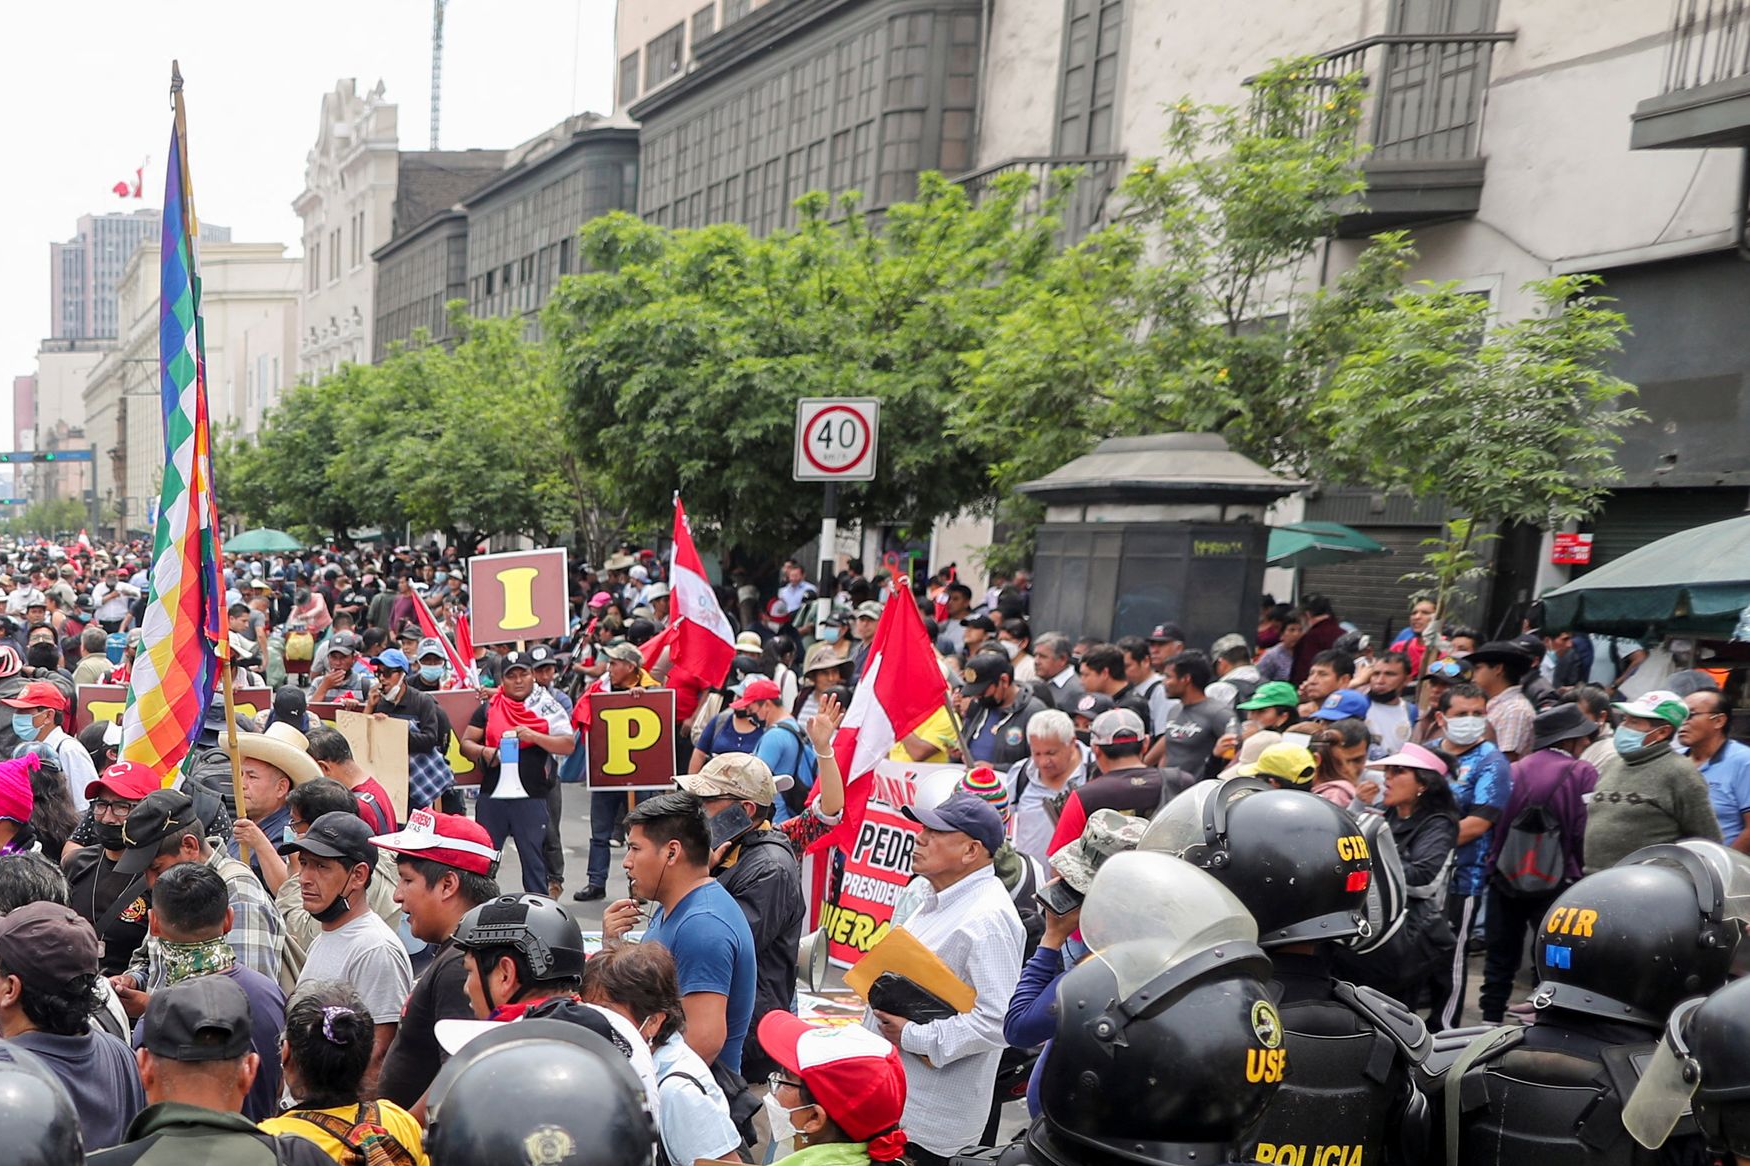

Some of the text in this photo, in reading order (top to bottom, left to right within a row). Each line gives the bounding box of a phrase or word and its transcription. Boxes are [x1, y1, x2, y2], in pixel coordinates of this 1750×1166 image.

[817, 419, 856, 449] 40
[496, 567, 540, 630] I
[600, 706, 661, 776] P
[851, 822, 915, 878] PEDR
[1337, 835, 1370, 861] GIR
[841, 871, 905, 907] PRESIDEN
[1546, 906, 1599, 938] GIR
[1245, 1048, 1286, 1083] USE
